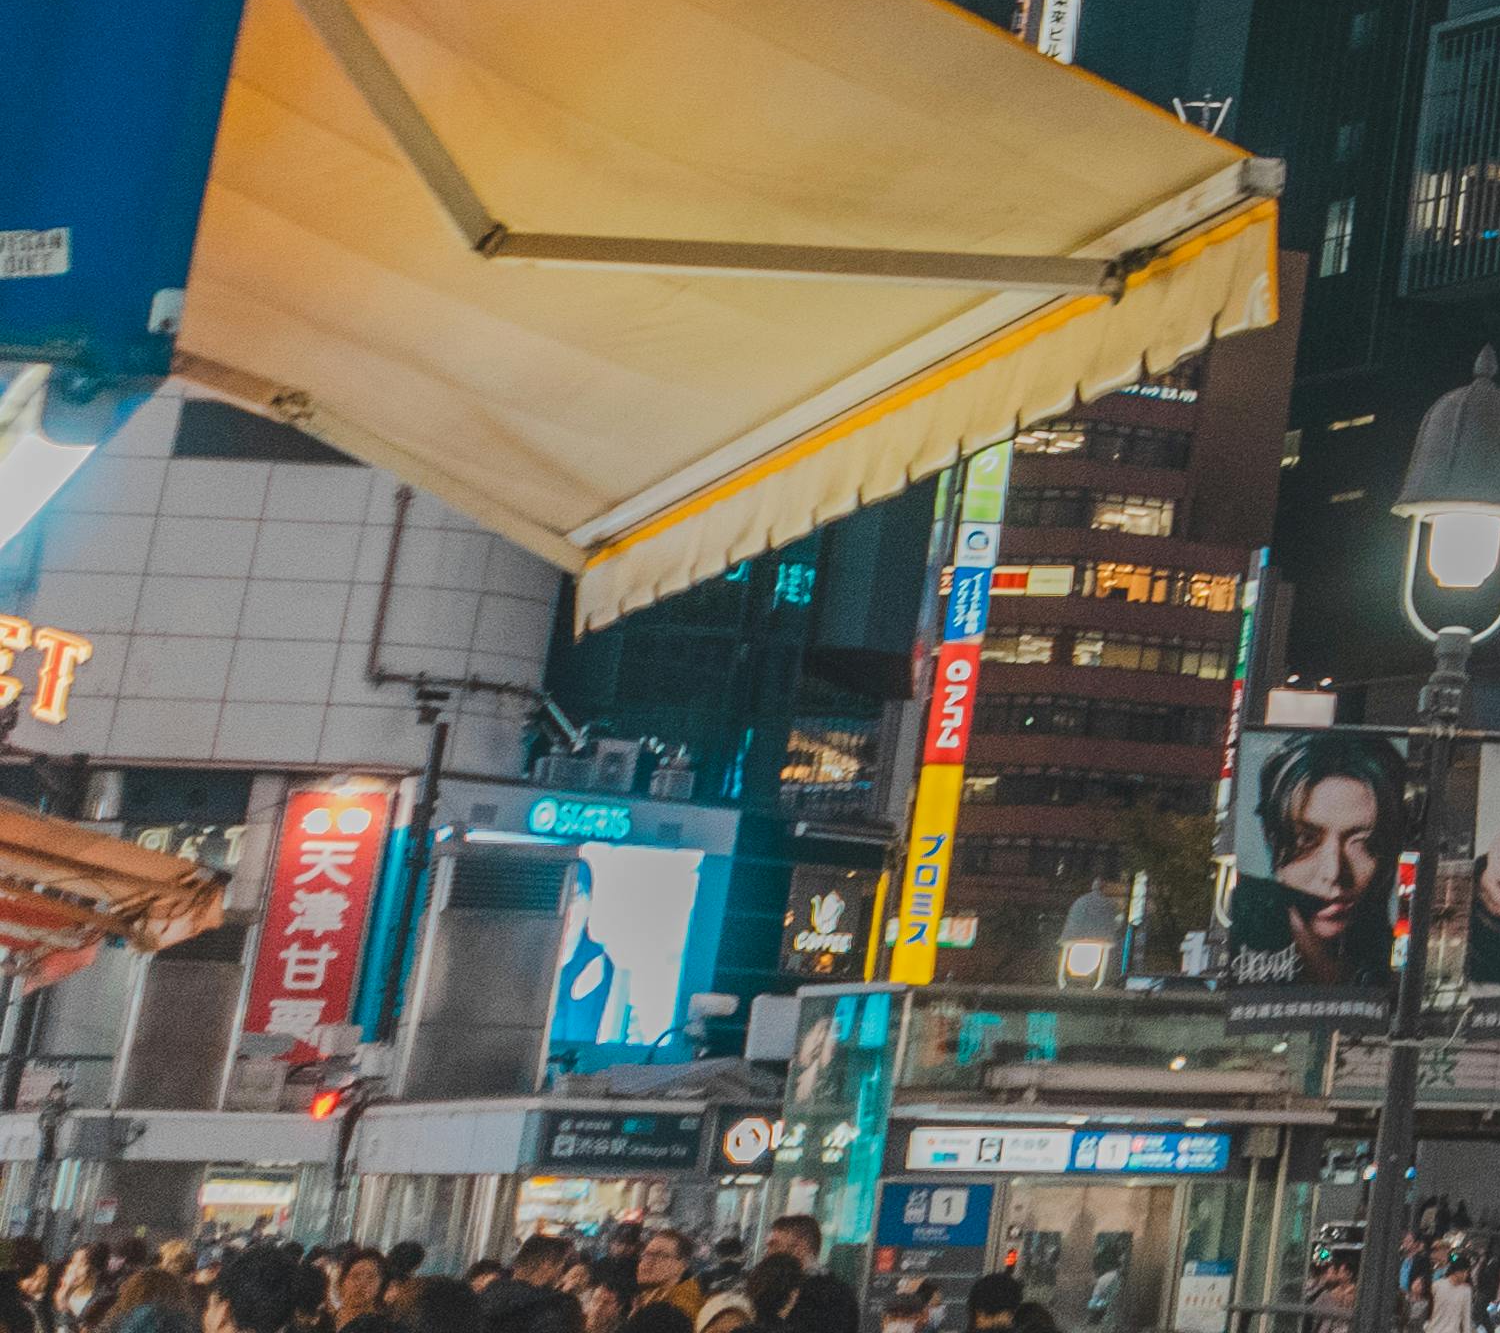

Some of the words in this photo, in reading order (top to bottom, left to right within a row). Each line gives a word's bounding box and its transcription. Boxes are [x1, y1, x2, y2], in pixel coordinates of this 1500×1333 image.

[936, 685, 968, 749] アコム
[904, 833, 948, 946] プロミス
